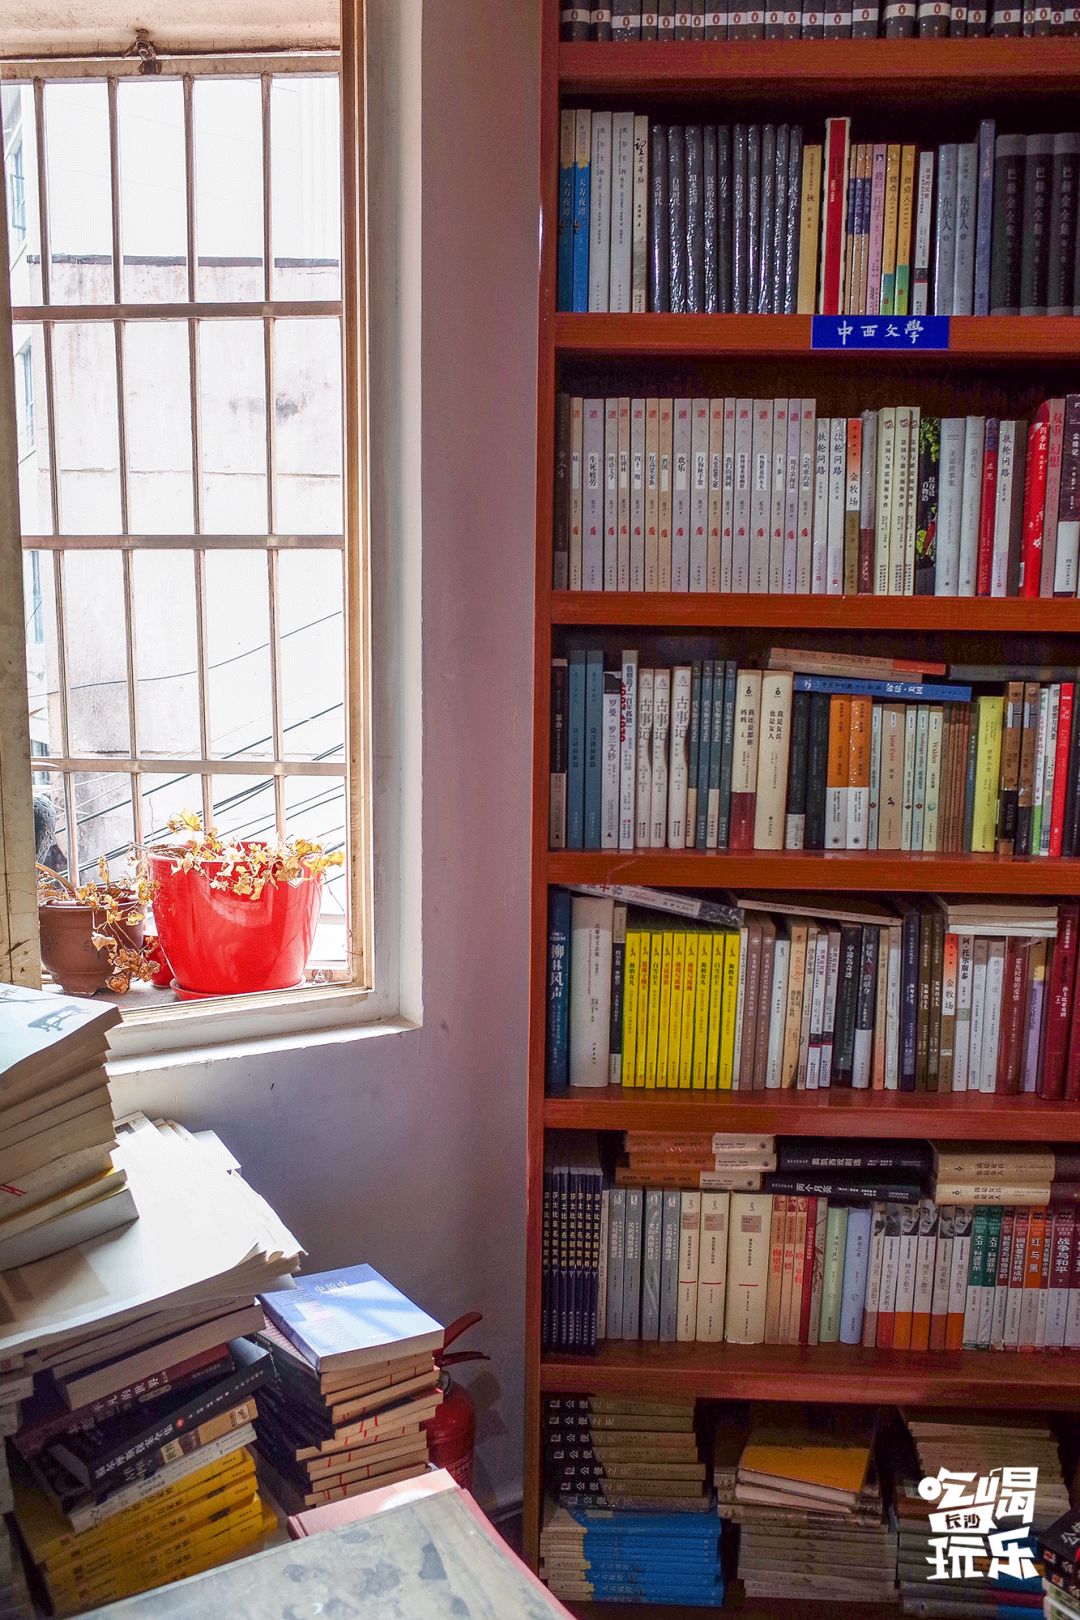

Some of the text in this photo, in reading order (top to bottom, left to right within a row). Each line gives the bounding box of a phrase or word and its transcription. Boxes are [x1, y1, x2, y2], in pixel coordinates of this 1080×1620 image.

[942, 196, 953, 232] 东京人
[959, 195, 971, 231] 东京人
[837, 318, 925, 346] 中西文學
[588, 455, 598, 487] 生死疲劳
[677, 456, 687, 472] 欢乐
[816, 432, 827, 475] 扶轮问路
[833, 432, 844, 475] 扶轮问路
[1000, 433, 1012, 478] 扶轮问路
[849, 471, 860, 507] 金牧场
[639, 697, 653, 740] 古事记
[655, 698, 669, 741] 古事记
[676, 696, 691, 739] 古事记
[767, 710, 776, 740] 也是女人
[932, 740, 940, 764] Walden
[550, 942, 565, 1001] 柳林风声
[960, 937, 972, 981] 阿·托尔斯泰
[944, 978, 955, 1011] 金牧场
[795, 1182, 833, 1194] 两个月亮
[973, 1234, 985, 1272] 大卫·科波菲尔
[987, 1236, 998, 1274] 大卫·科波菲尔
[1012, 1237, 1026, 1282] 钢铁是怎样炼成的
[1029, 1237, 1041, 1273] 红与黑
[1055, 1237, 1071, 1274] 战争与和平
[93, 1376, 160, 1412] 平凡的世界
